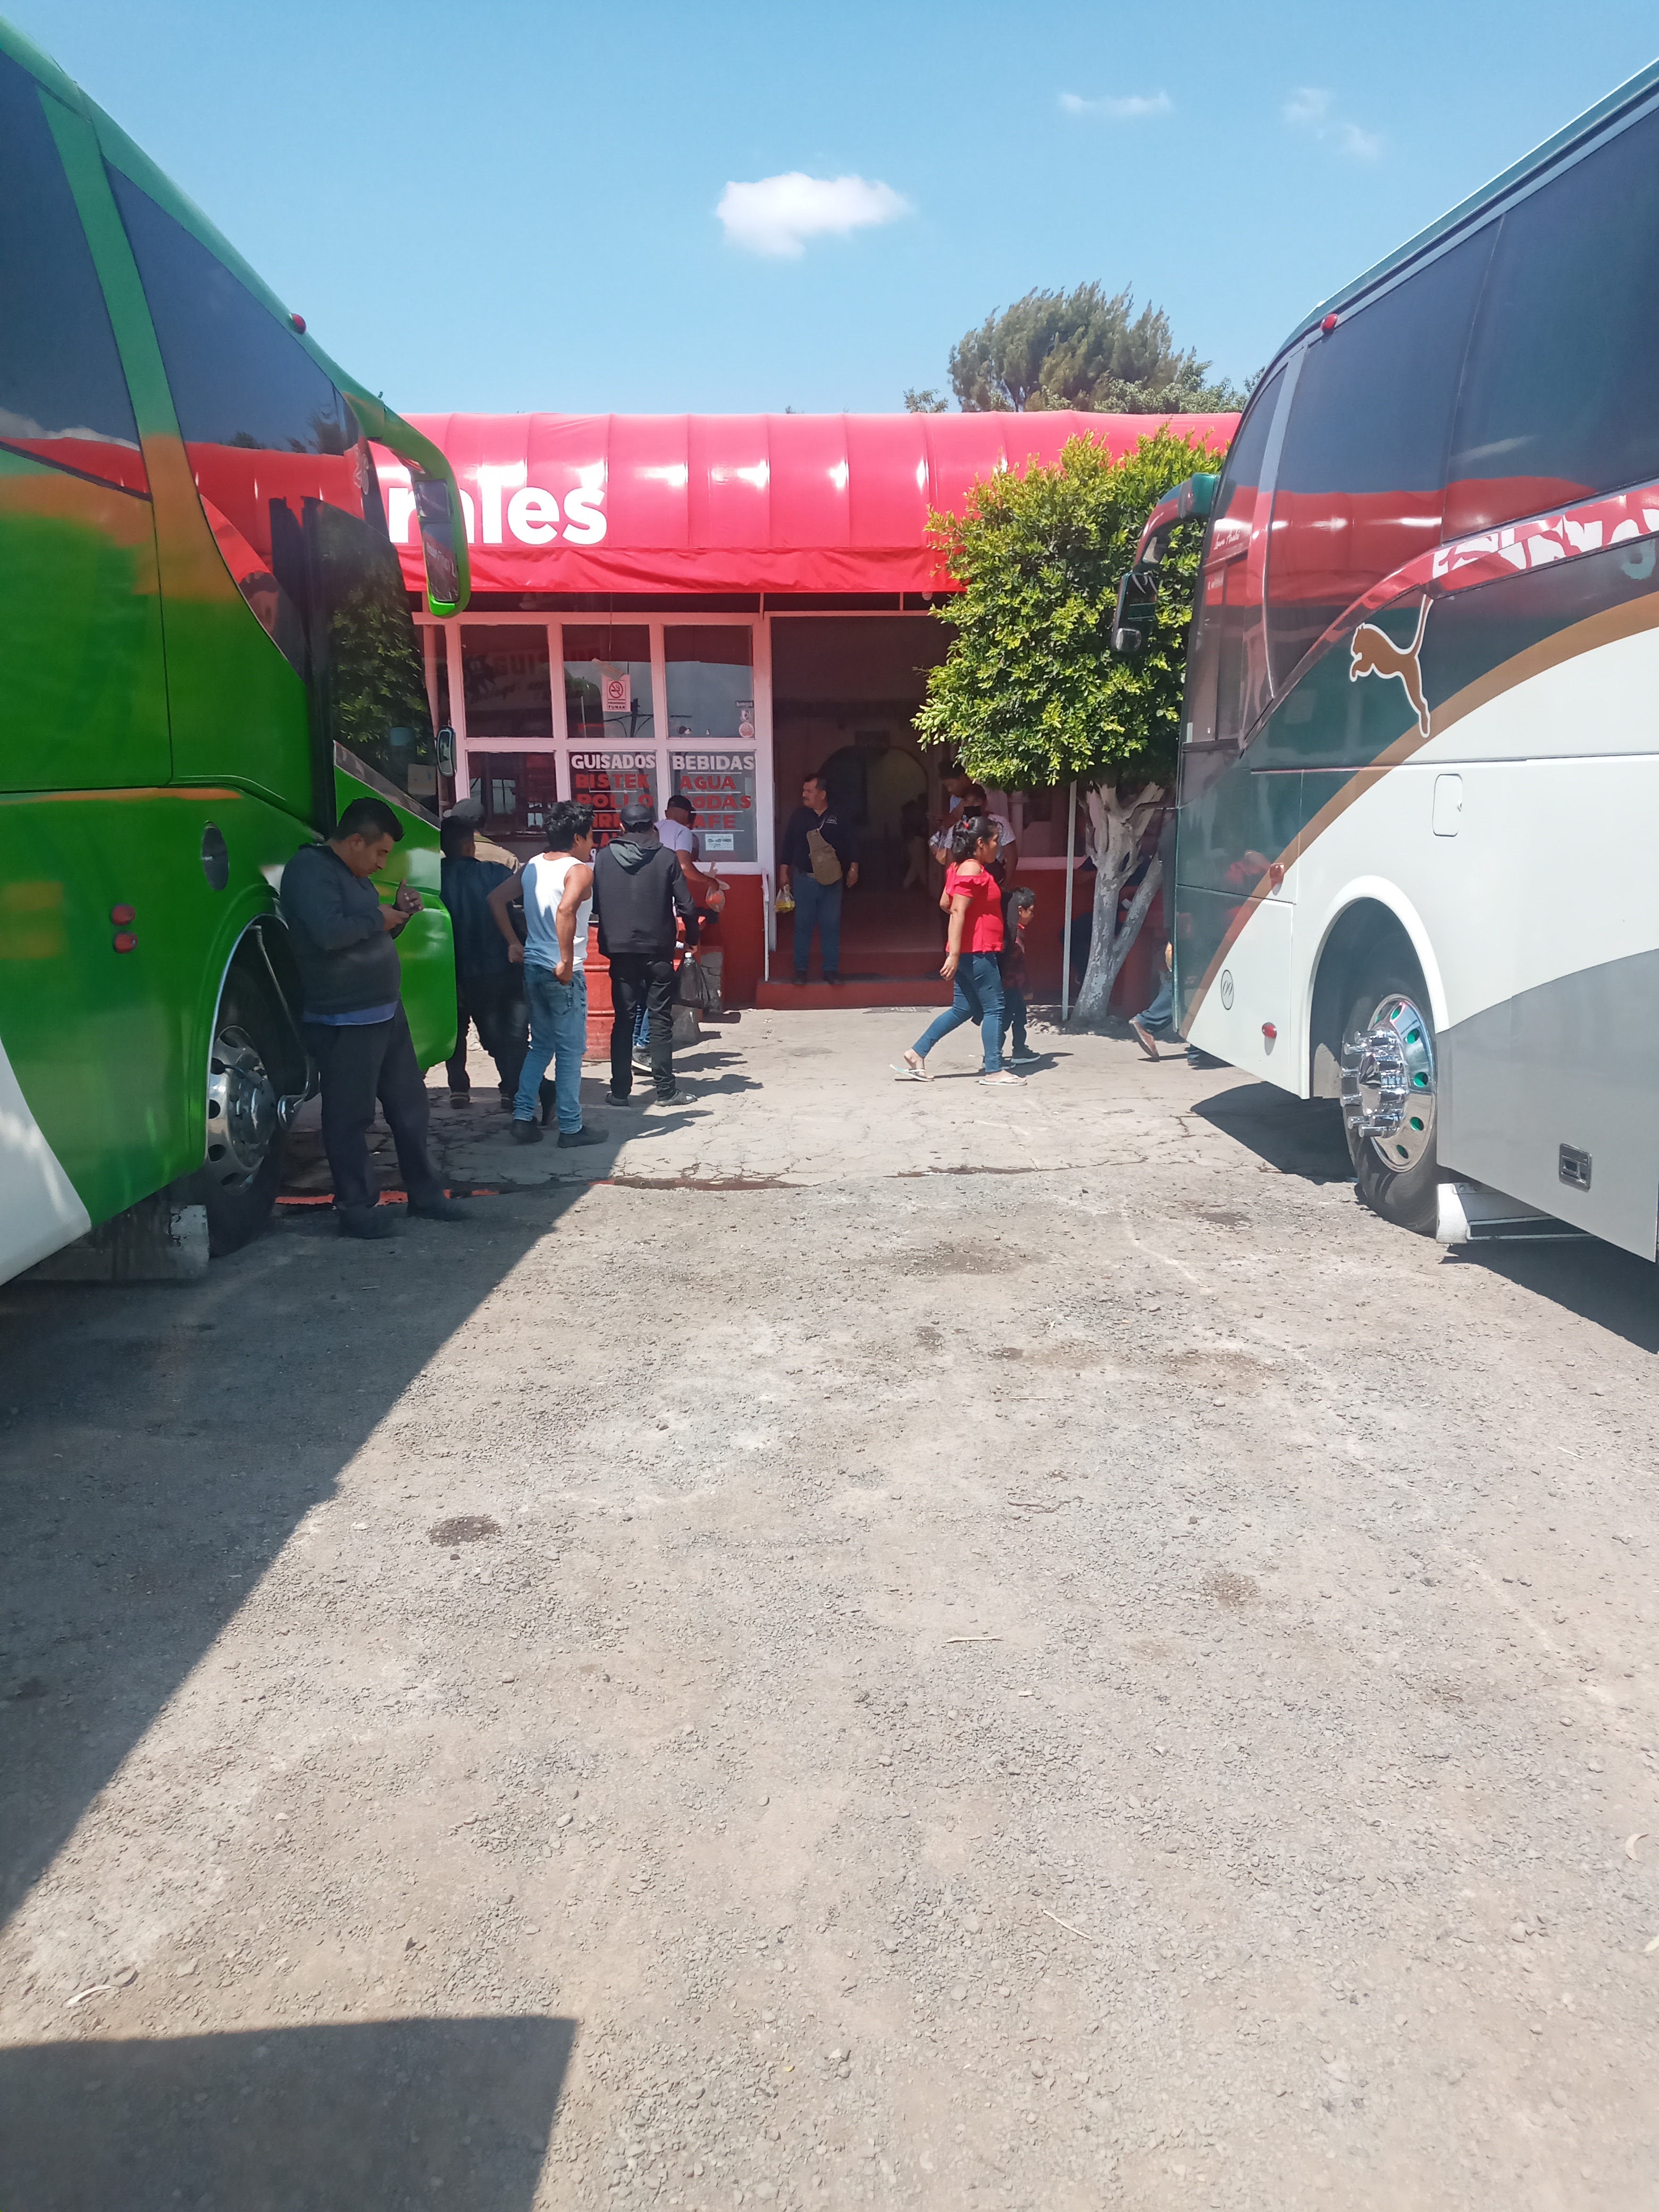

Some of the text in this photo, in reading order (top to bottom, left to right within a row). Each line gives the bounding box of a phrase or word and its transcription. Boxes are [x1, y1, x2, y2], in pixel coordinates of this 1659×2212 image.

[571, 755, 655, 769] GUISADOS
[673, 756, 755, 770] BEBIDAS
[575, 774, 650, 788] BISTEK
[680, 776, 736, 789] AGUA
[693, 815, 736, 828] AFE
